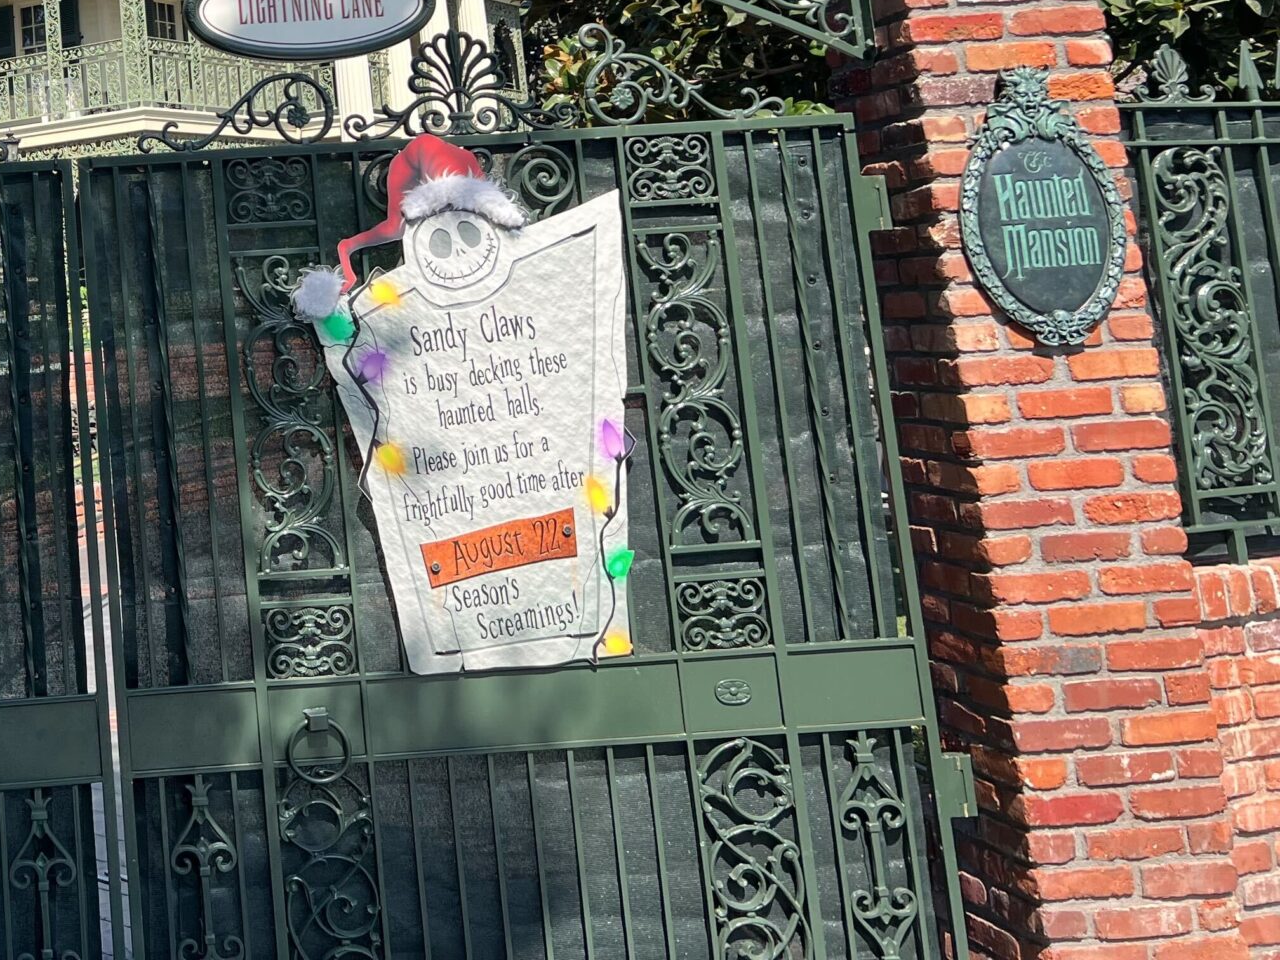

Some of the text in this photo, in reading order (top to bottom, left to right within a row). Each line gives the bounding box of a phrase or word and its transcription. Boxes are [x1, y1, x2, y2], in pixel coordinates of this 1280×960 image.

[1017, 150, 1053, 173] The
[992, 167, 1092, 221] Haunted
[1001, 220, 1102, 281] Mansion
[410, 305, 536, 362] Sandy Claws
[403, 347, 568, 398] is busy decking these
[436, 382, 544, 429] haunted halls.
[412, 430, 550, 475] Please join us for a
[403, 460, 585, 526] frightfully good time after
[452, 518, 561, 576] August 22
[452, 577, 520, 612] Season's
[476, 590, 580, 640] Screamings!
